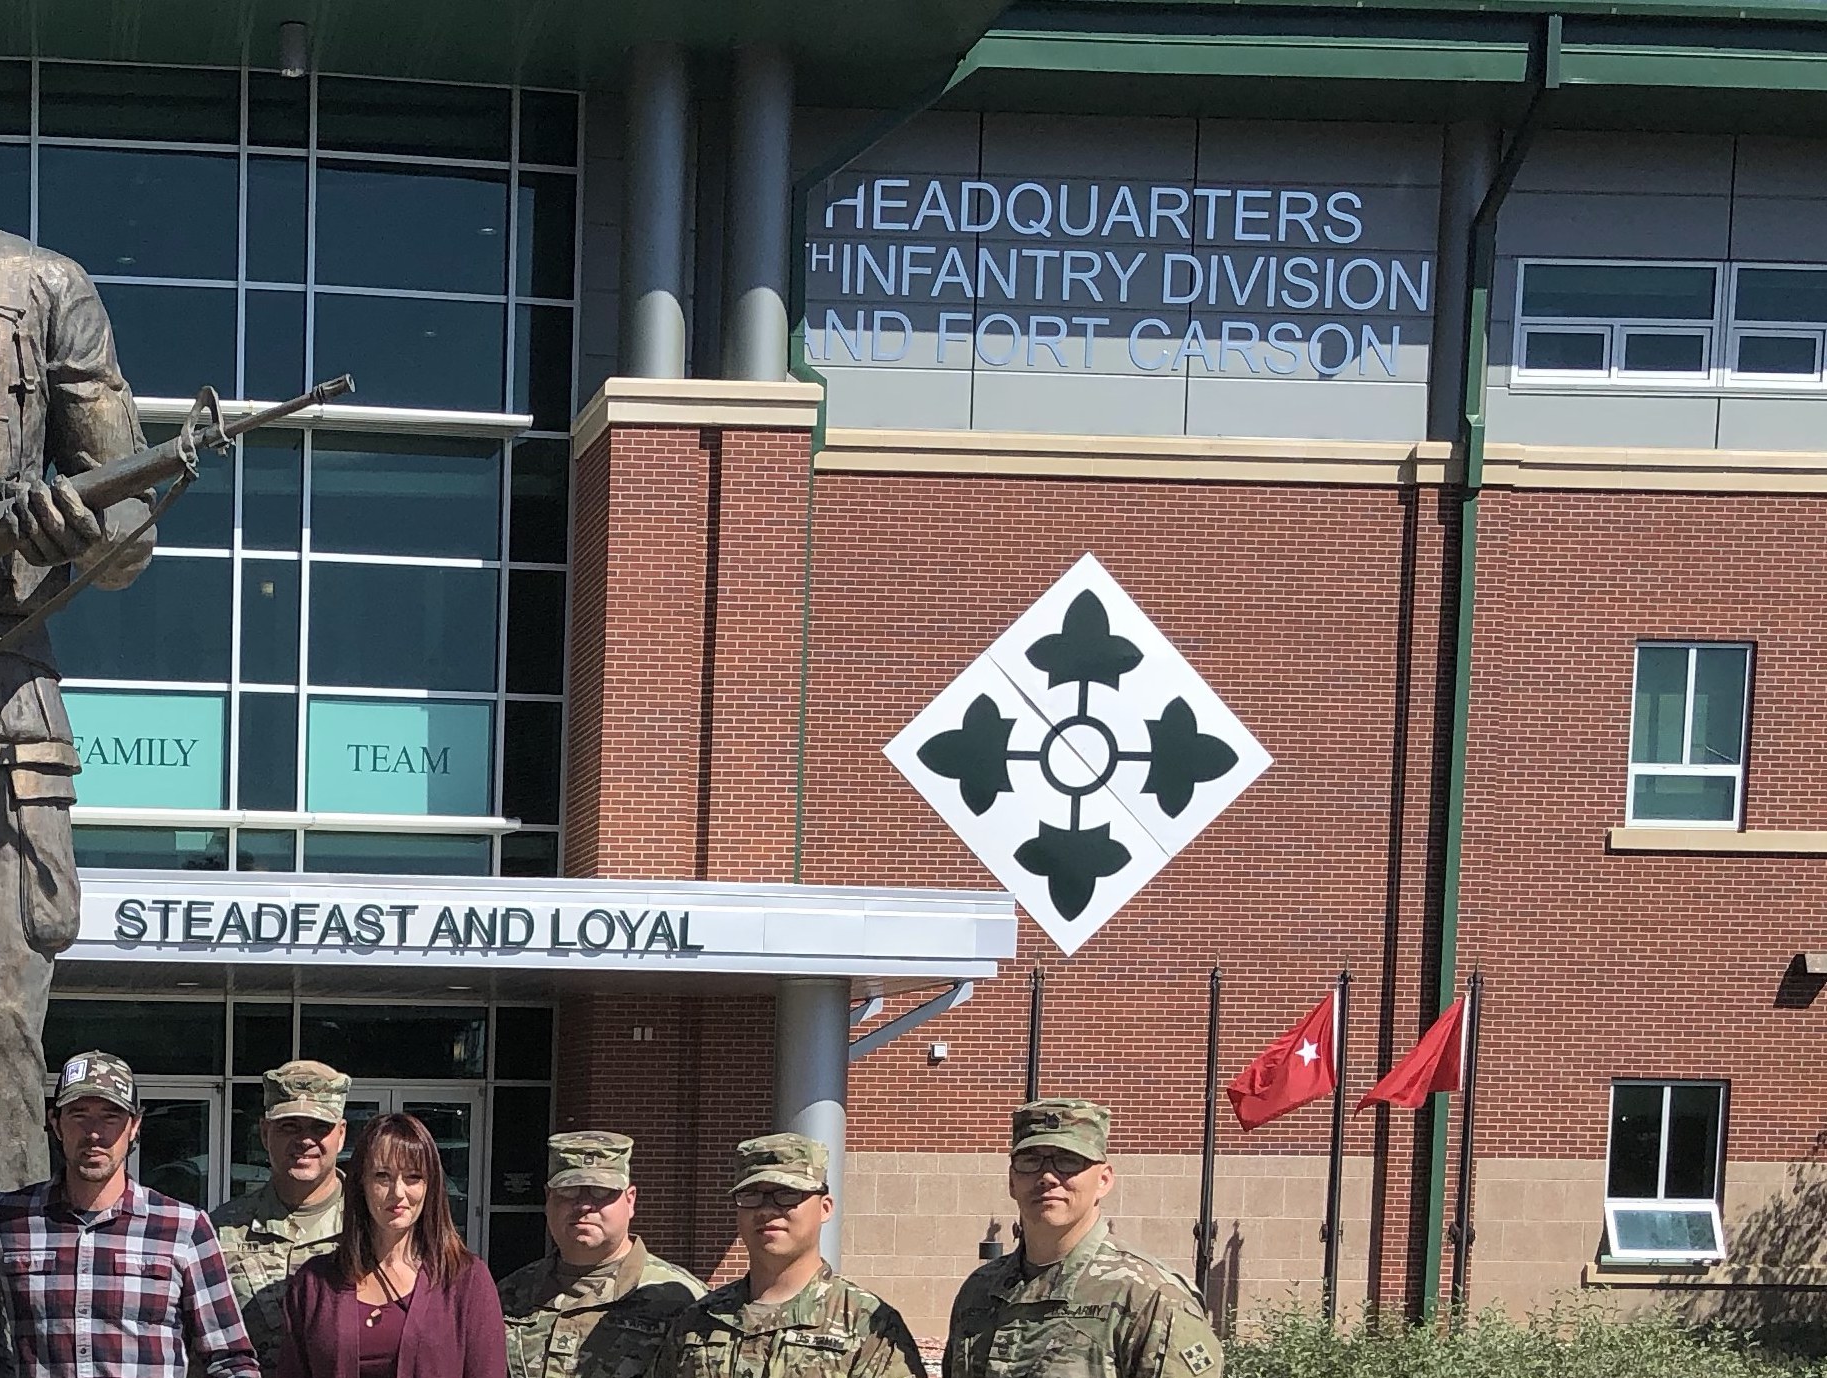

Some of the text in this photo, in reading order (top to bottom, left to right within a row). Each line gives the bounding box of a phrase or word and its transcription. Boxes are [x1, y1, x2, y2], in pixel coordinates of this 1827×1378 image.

[825, 179, 1362, 244] HEADQUARTERS
[842, 243, 1147, 303] INFANTRY
[1162, 253, 1430, 311] DIVISION
[937, 312, 1110, 368] FORT
[1127, 318, 1401, 377] CARSON
[347, 744, 452, 775] TEAM
[116, 900, 705, 952] STEADFAST AND LOYAL
